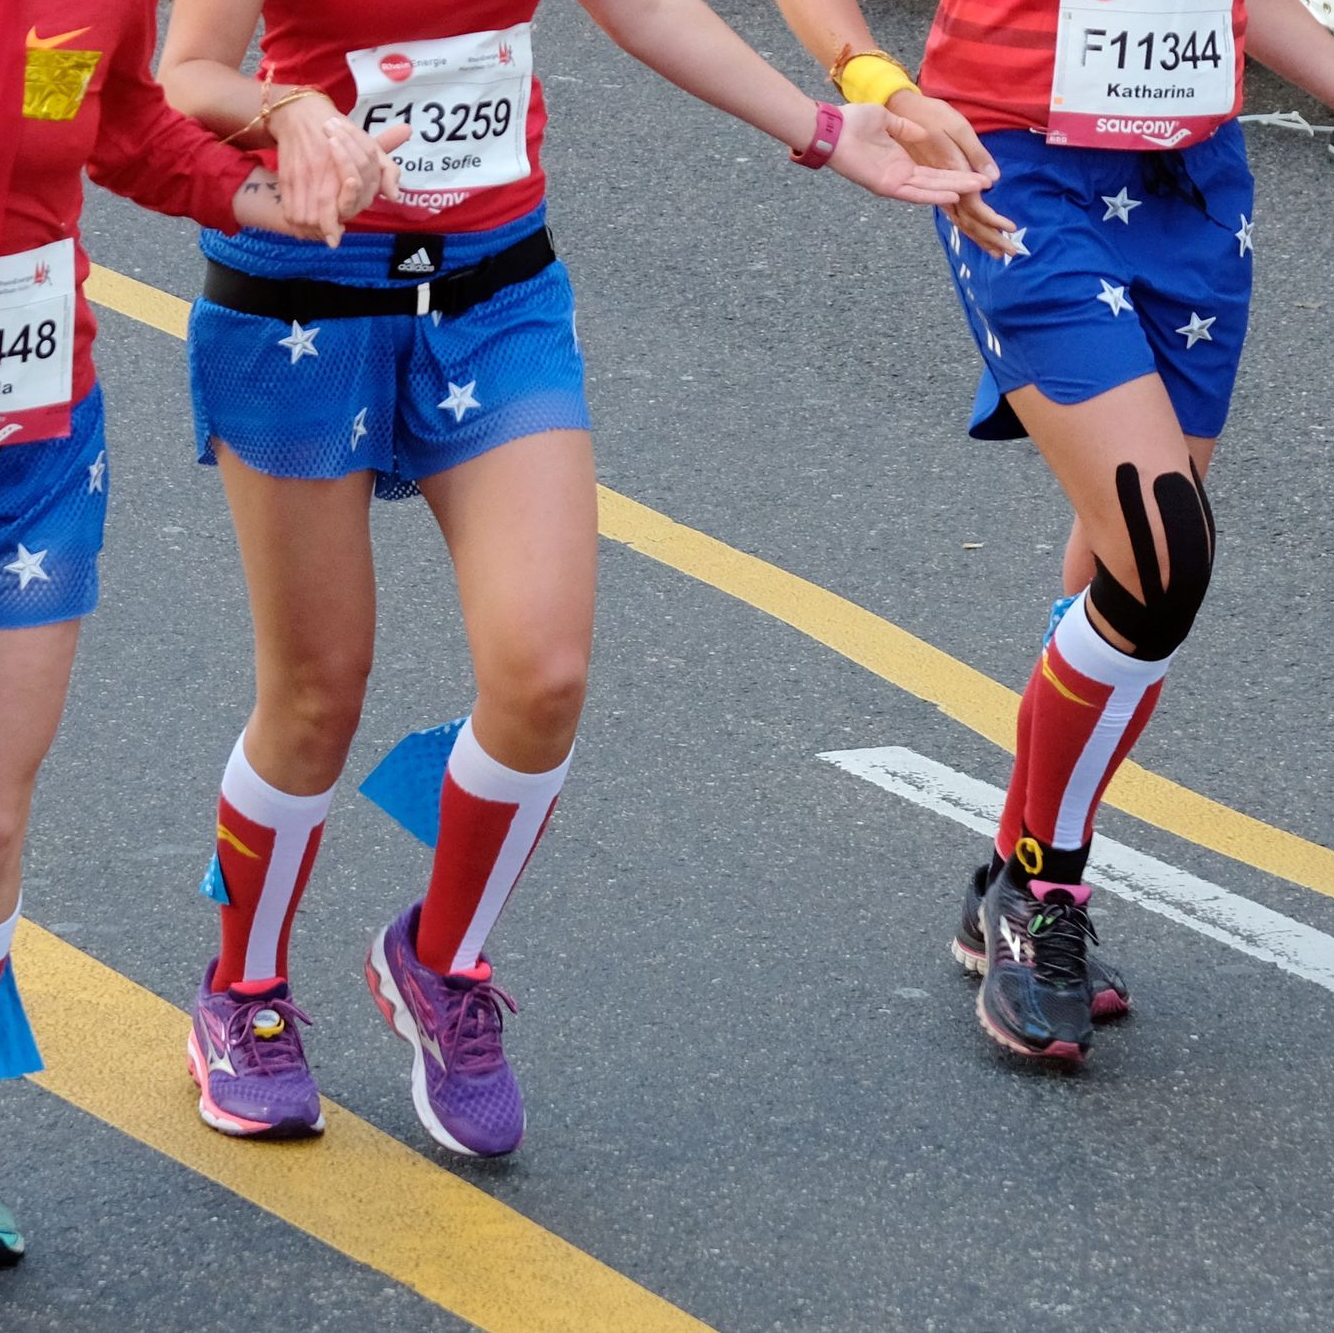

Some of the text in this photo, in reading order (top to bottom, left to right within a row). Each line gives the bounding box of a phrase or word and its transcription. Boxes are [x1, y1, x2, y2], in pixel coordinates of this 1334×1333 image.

[1080, 27, 1222, 71] F11344
[1106, 82, 1196, 99] Katharina
[362, 98, 512, 143] F13259
[1095, 117, 1177, 137] saucony
[441, 153, 483, 172] Sofie
[397, 263, 435, 273] adidas
